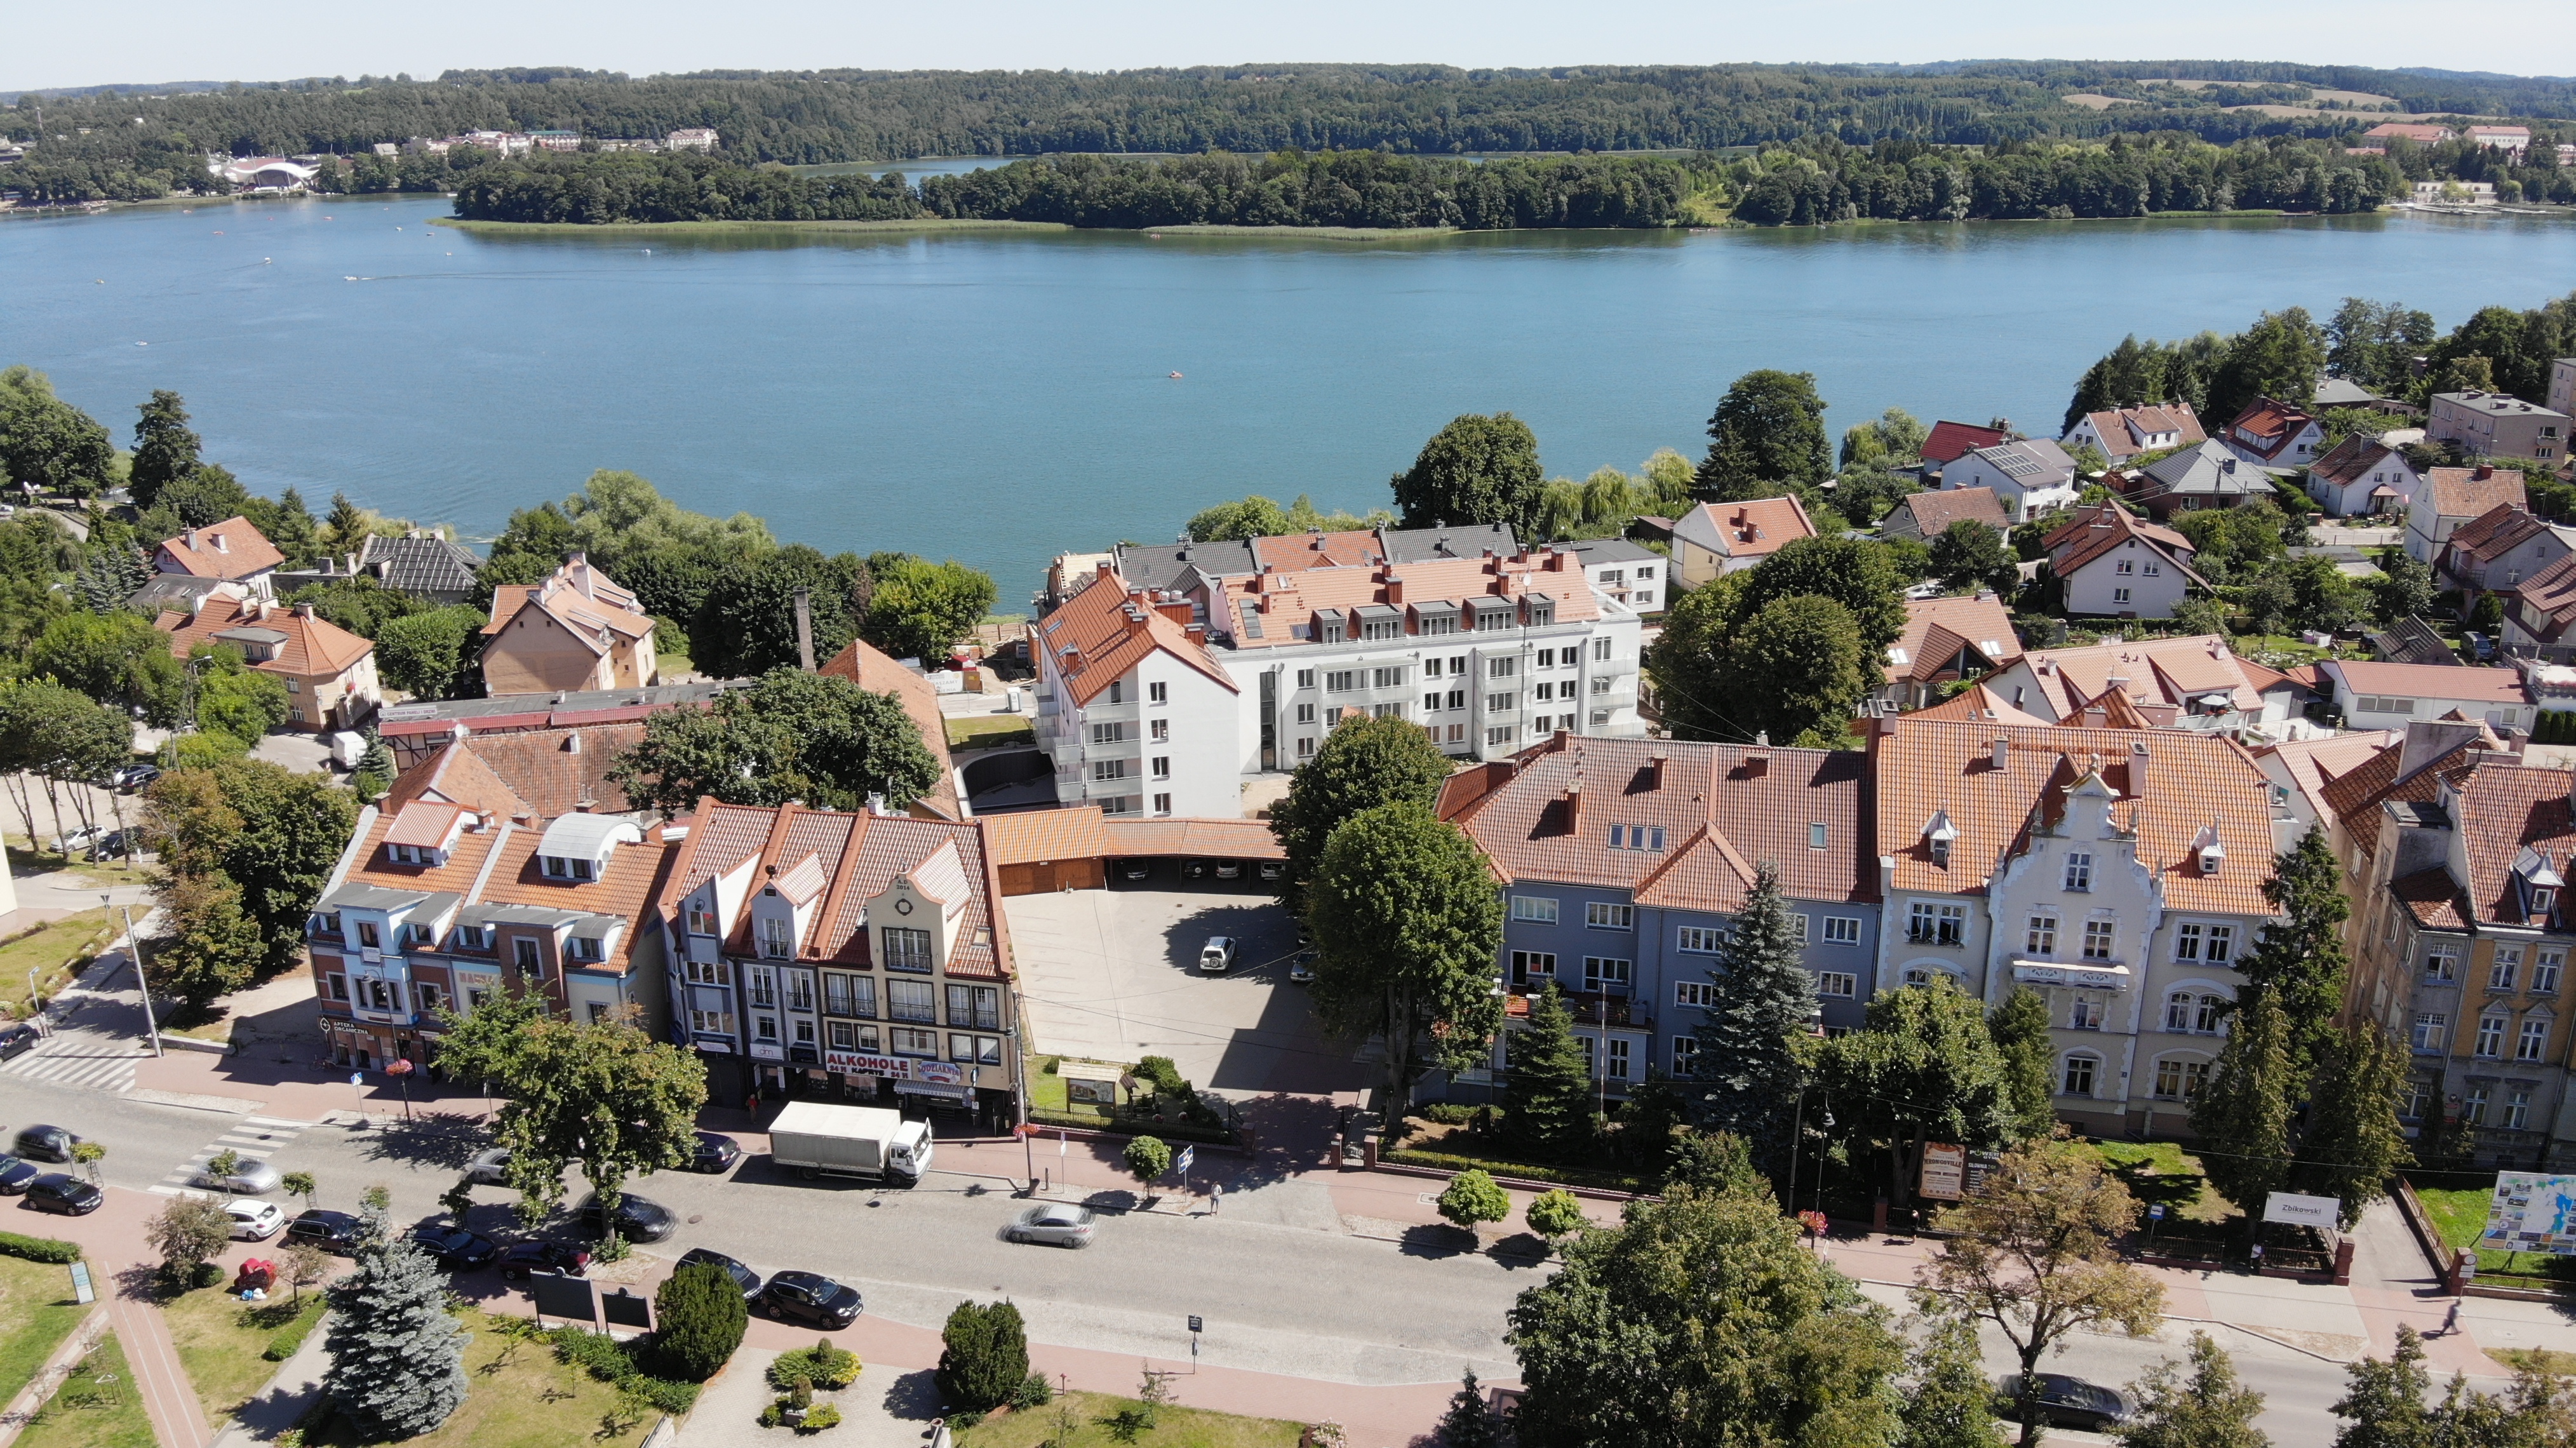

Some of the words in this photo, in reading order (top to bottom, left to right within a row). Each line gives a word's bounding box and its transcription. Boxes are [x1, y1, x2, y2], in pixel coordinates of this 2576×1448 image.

[334, 1026, 368, 1035] ORGANICZNA
[827, 1053, 908, 1072] ALKOHOLE
[851, 1067, 885, 1076] KAPRYS
[1969, 1148, 1999, 1157] POWER
[1924, 1158, 1962, 1168] MRONGOVILLE
